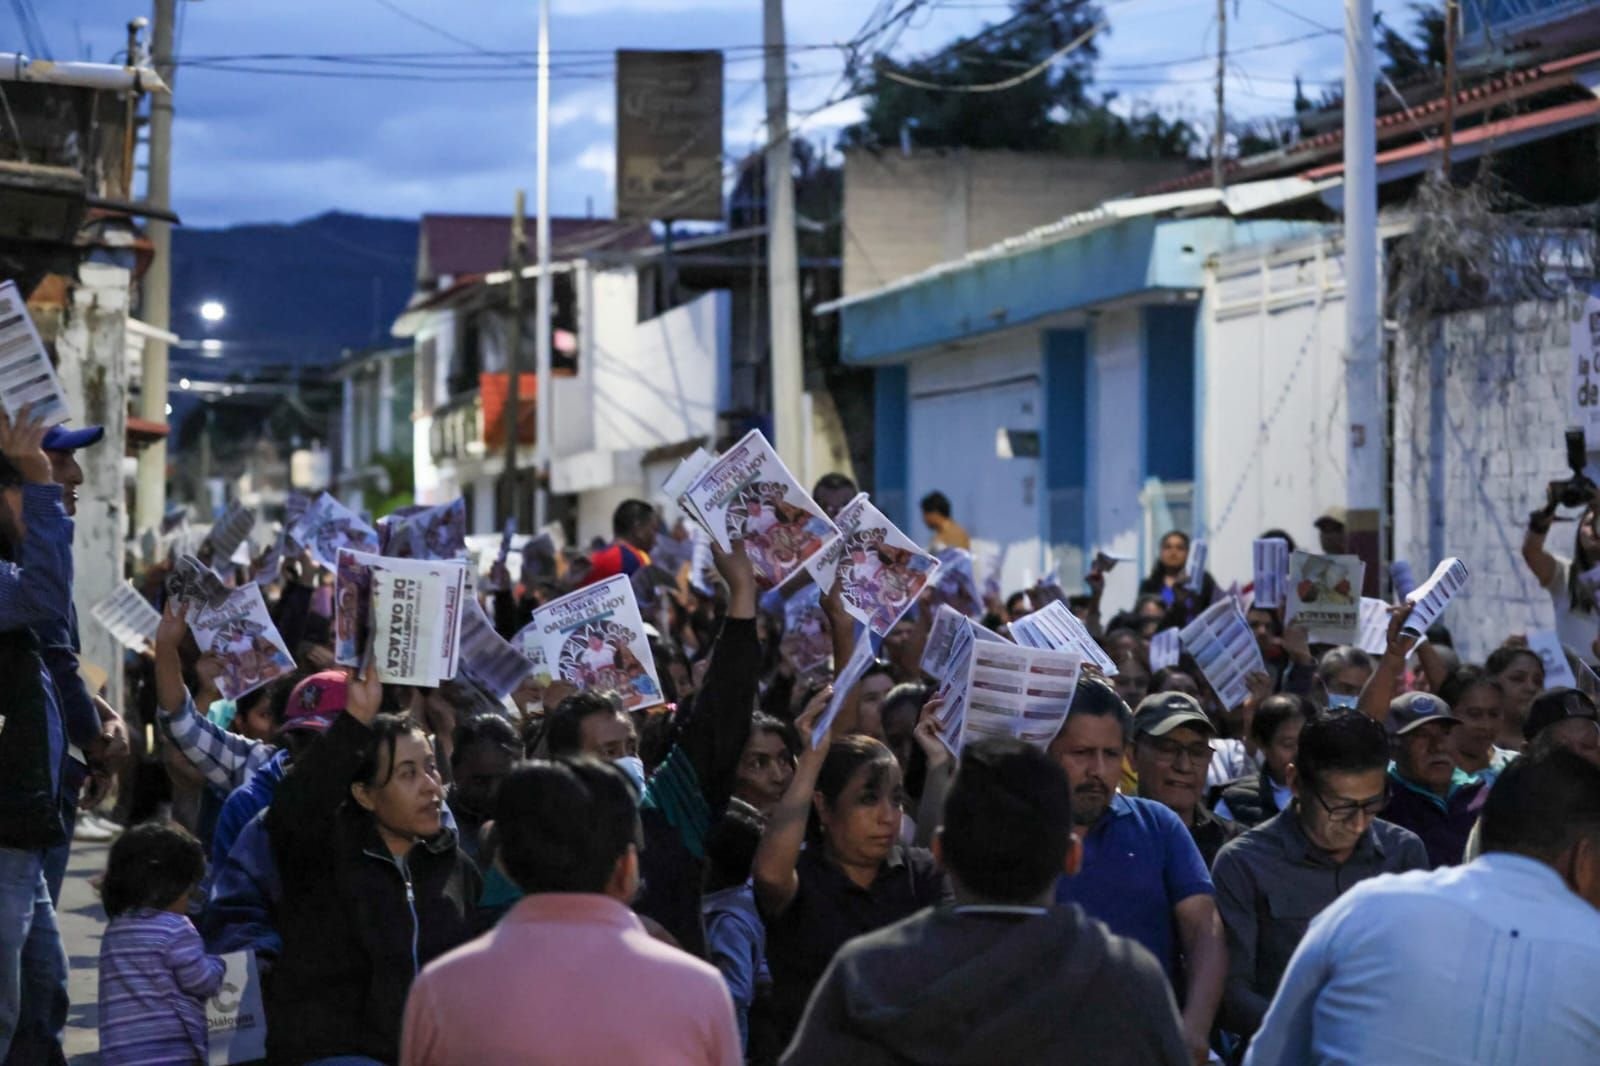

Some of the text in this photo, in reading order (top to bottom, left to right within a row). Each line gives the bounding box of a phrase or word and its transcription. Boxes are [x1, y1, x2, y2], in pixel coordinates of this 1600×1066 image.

[744, 451, 769, 473] HOY
[386, 578, 407, 677] DE OAXACA?
[542, 609, 584, 635] OAXACA
[584, 603, 601, 617] DE
[601, 594, 627, 610] HOY
